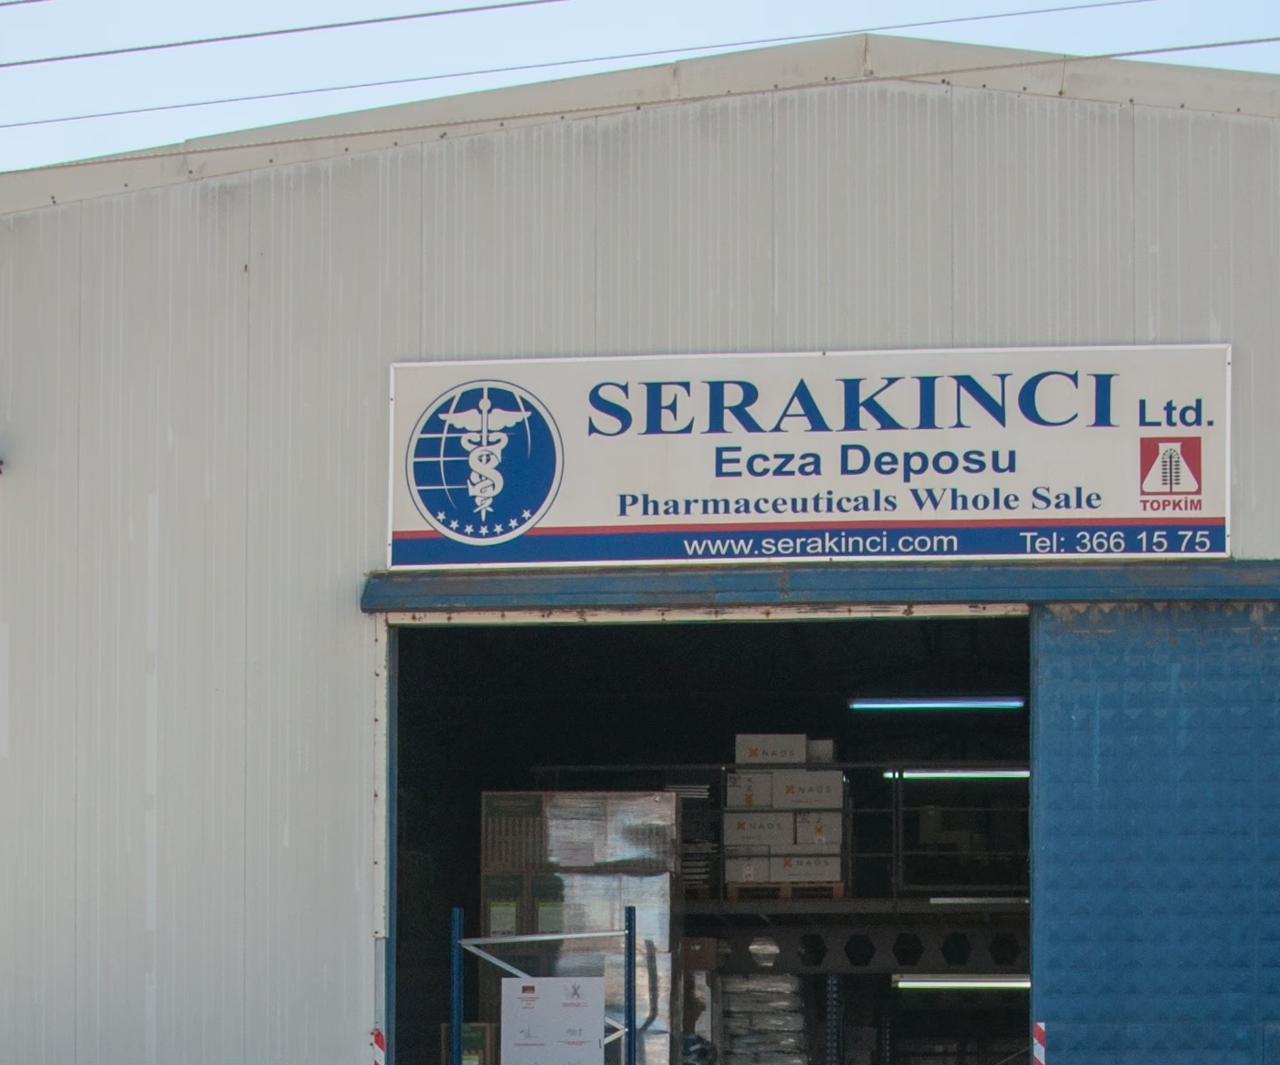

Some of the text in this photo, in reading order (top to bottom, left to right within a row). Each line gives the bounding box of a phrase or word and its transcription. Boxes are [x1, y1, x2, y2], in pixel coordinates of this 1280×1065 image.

[588, 370, 1215, 437] SERAKINCI Ltd.
[715, 444, 1017, 483] Ecza Deposu
[617, 486, 1103, 517] Pharmaceuticals Whole Sale
[1139, 496, 1203, 512] TOPKİM
[683, 530, 1211, 556] www.serakinci.com Tel: 366 15 75
[798, 785, 832, 794] NAOS
